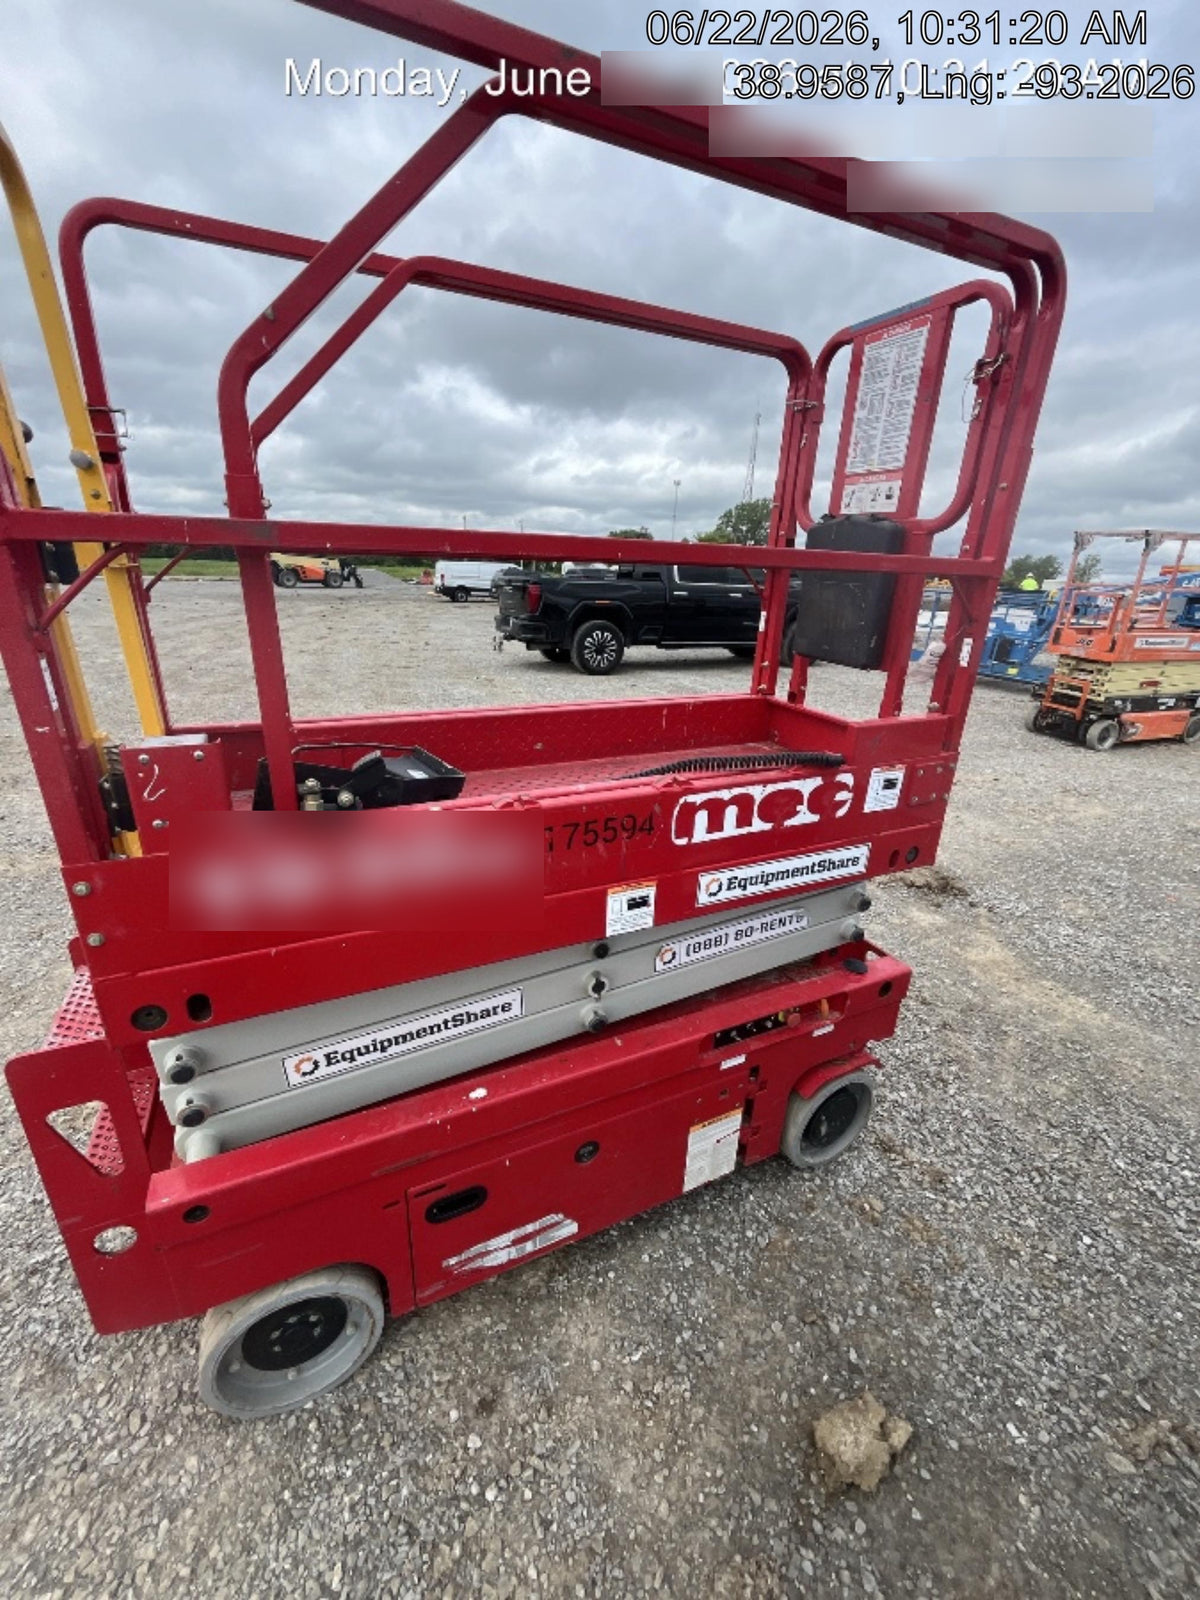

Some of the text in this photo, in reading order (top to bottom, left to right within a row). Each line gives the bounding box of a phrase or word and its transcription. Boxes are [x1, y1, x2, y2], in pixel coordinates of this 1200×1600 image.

[726, 855, 861, 892] EquipmentShare
[685, 932, 730, 957] (888)
[322, 1000, 514, 1067] EquipmentShare
